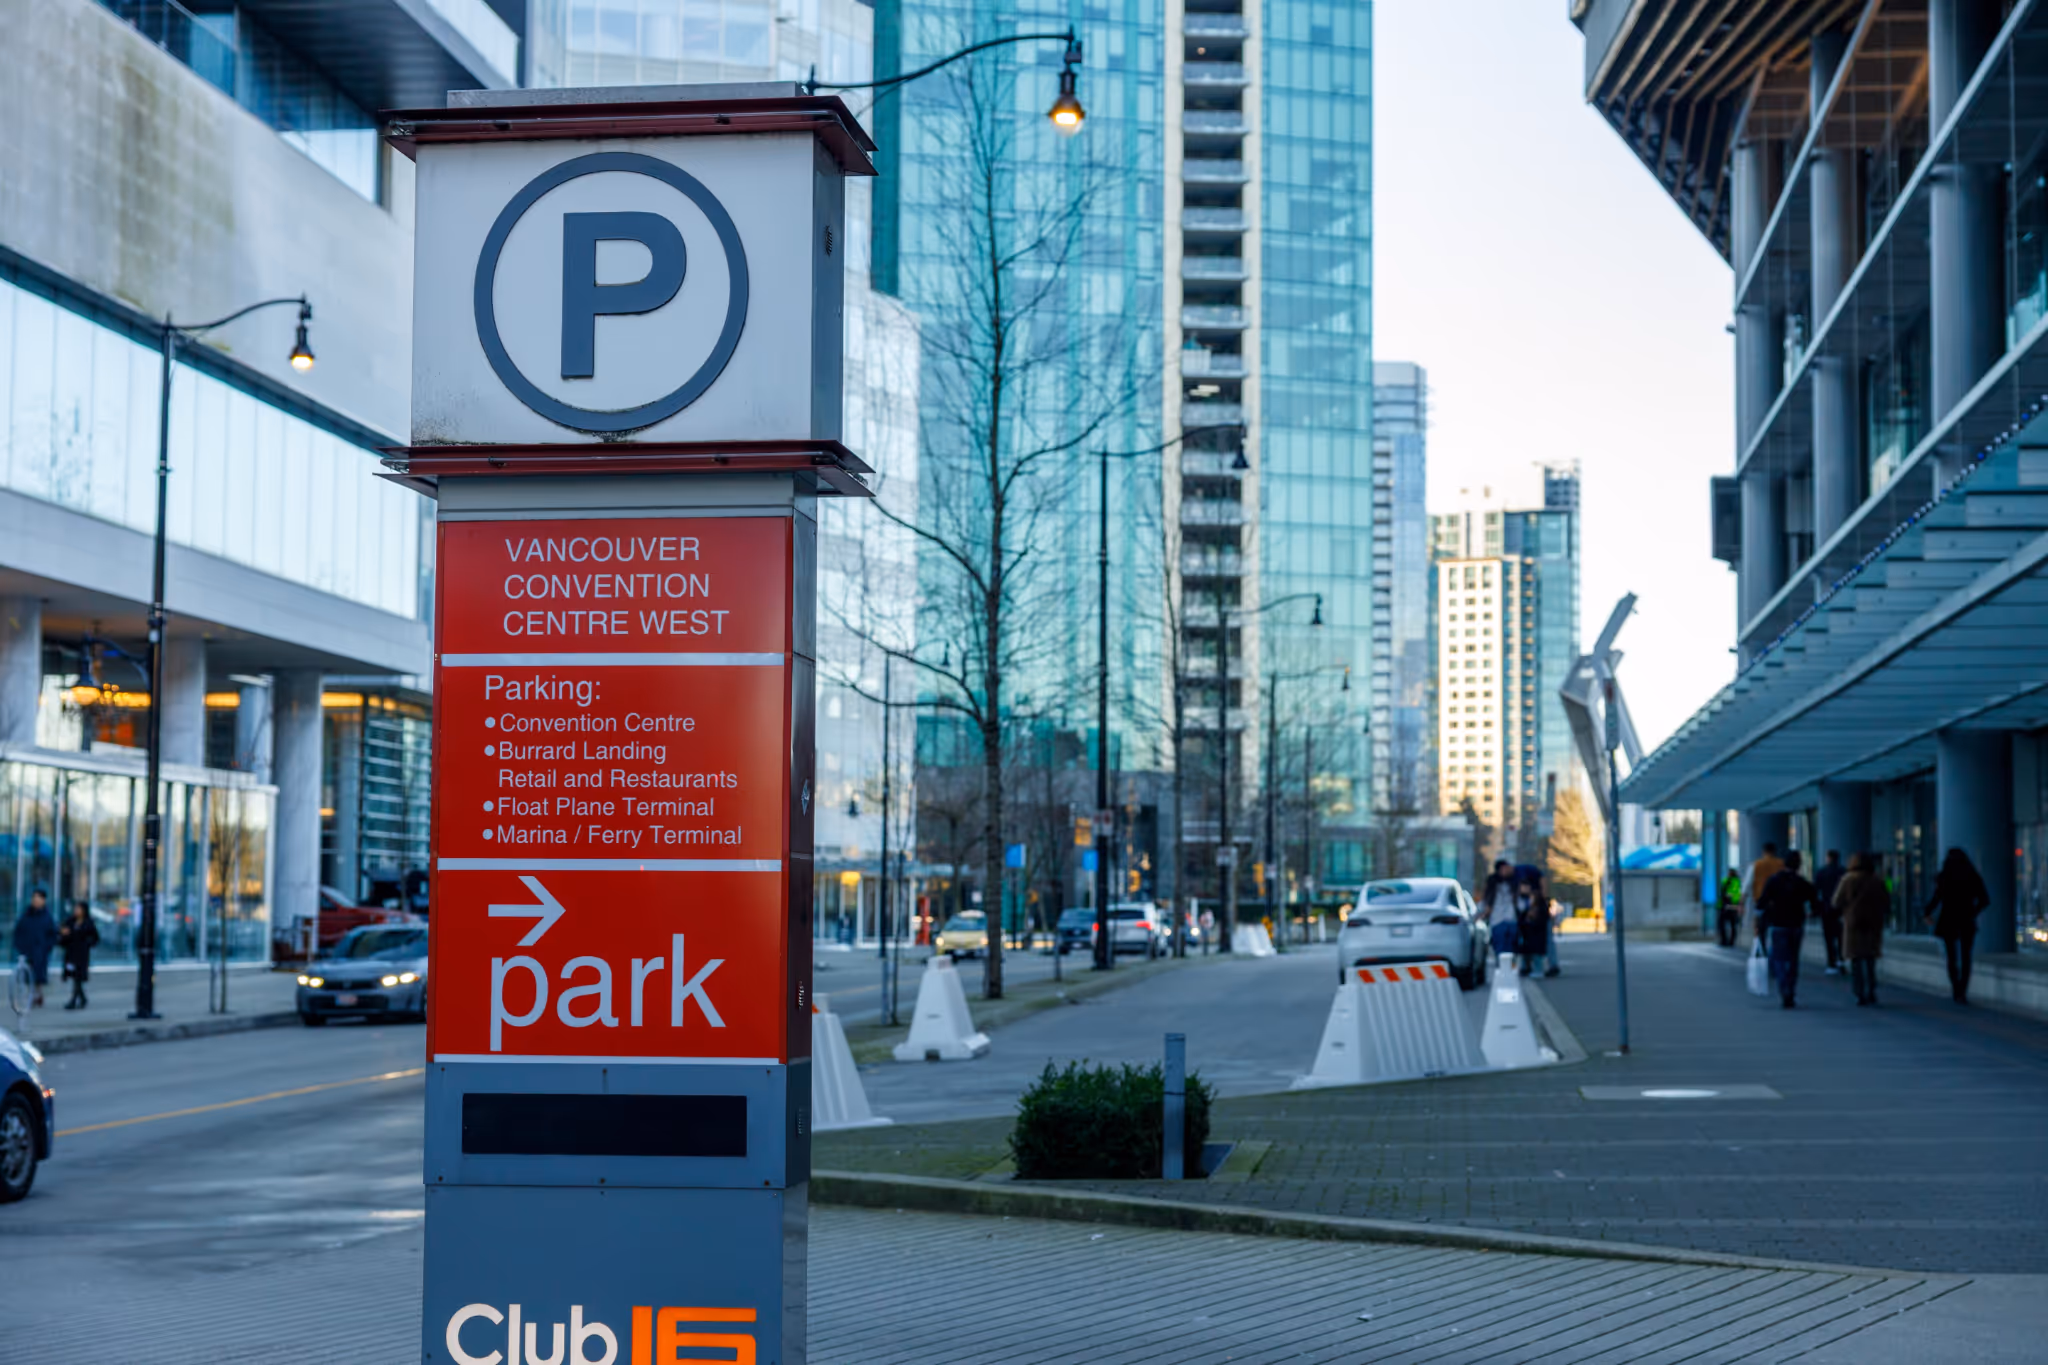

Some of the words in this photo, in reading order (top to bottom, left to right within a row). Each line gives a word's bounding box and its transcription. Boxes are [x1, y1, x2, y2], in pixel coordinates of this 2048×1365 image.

[561, 210, 687, 380] P
[504, 536, 700, 563] VANCOUVER
[503, 572, 710, 600] CONVENTION
[503, 610, 629, 637] CENTRE
[639, 609, 731, 636] WEST
[484, 674, 601, 708] Parking:
[500, 712, 617, 733] Convention
[624, 712, 696, 732] Centre
[499, 740, 576, 760] Burrard
[583, 740, 666, 765] Landing
[498, 768, 557, 788] Retail
[563, 768, 603, 788] and
[610, 768, 738, 789] Restaurants
[498, 796, 549, 816] Float
[556, 796, 615, 816] Plane
[622, 797, 714, 816] Terminal
[497, 824, 568, 844] Marina
[573, 824, 582, 844] /
[588, 824, 643, 849] Ferry
[649, 825, 742, 845] Terminal
[489, 933, 726, 1052] park
[446, 1303, 618, 1365] Club
[631, 1305, 756, 1365] 16
